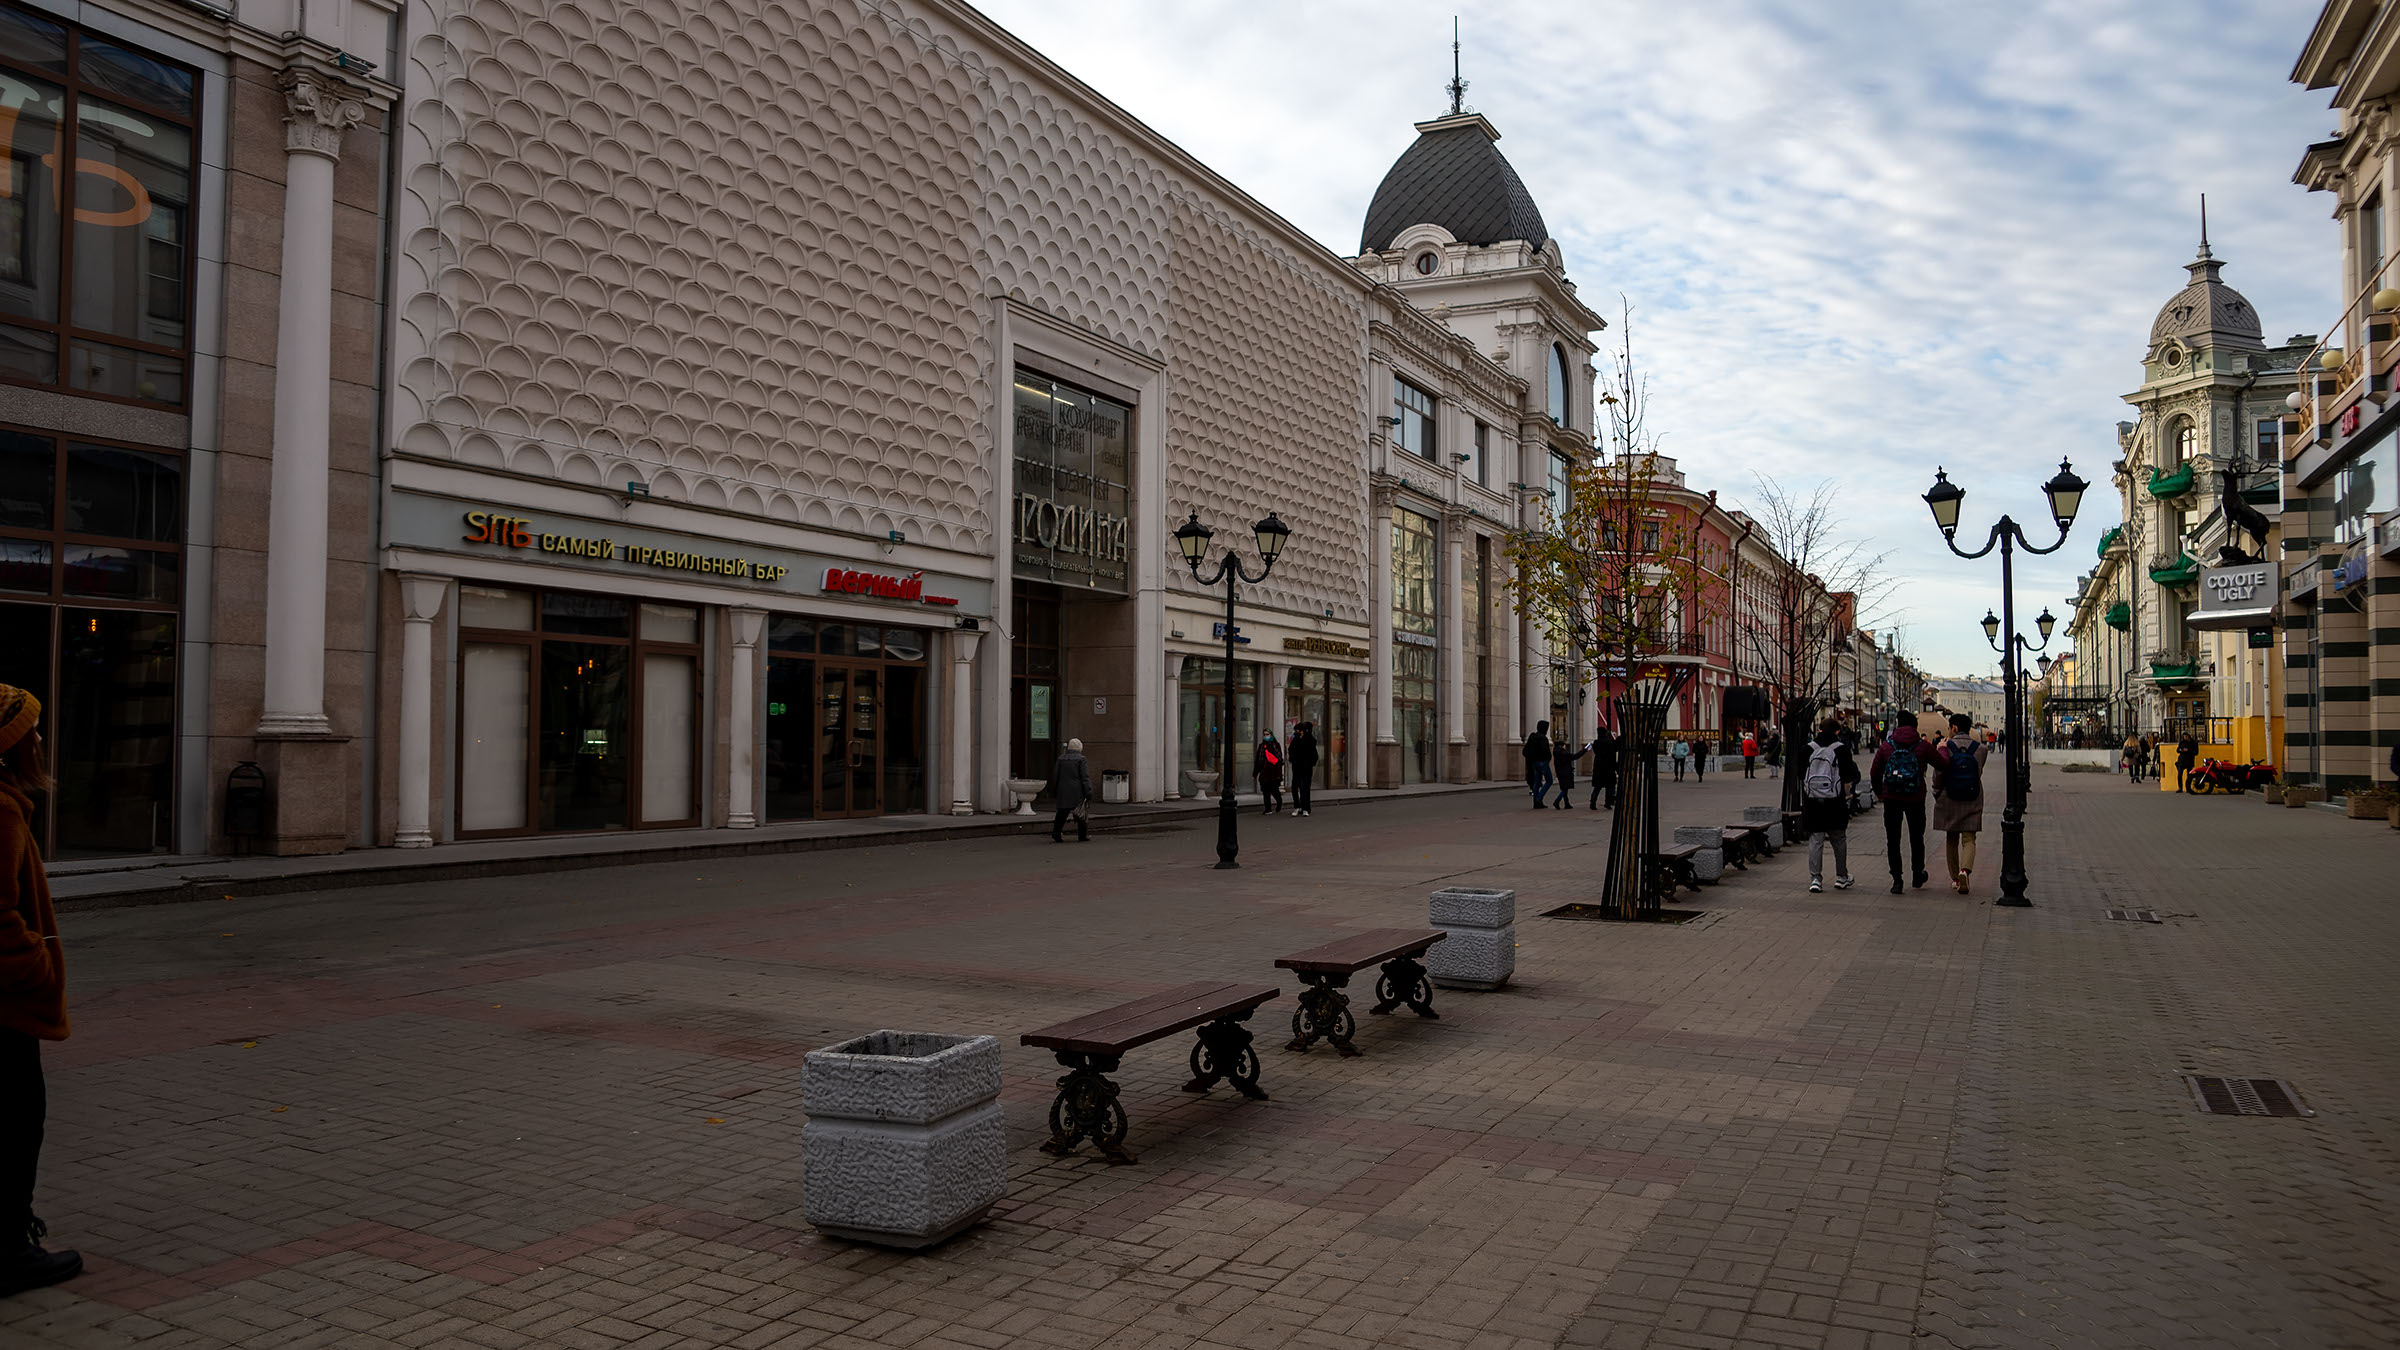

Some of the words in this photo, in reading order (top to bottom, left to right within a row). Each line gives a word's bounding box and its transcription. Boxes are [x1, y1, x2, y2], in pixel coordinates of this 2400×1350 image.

[1020, 492, 1127, 563] РОДИНА
[541, 532, 615, 559] САМЫЙ
[628, 545, 748, 577] ПРАВИЛЬНЫЙ
[756, 562, 786, 582] БАР
[2207, 571, 2265, 589] COYOTE
[2217, 586, 2254, 602] UGLY
